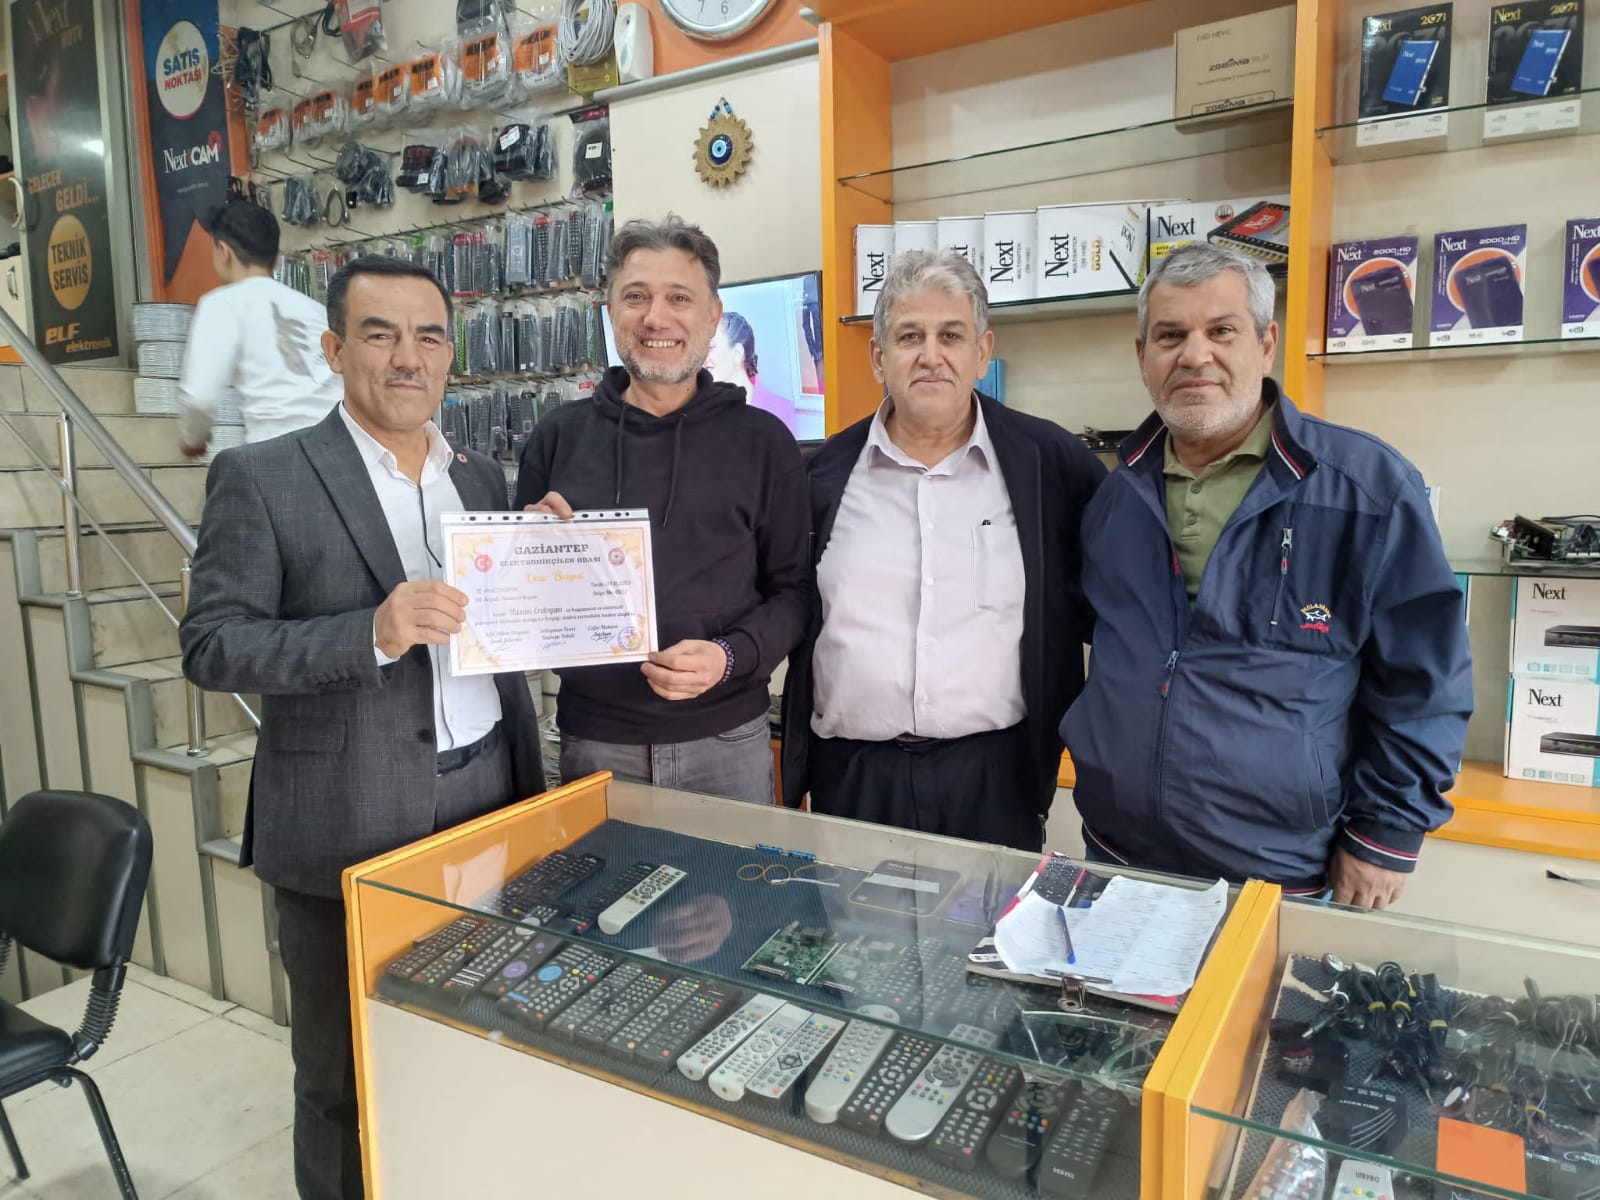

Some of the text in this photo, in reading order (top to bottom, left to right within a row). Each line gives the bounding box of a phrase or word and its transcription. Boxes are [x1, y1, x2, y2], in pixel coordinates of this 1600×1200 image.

[720, 0, 729, 15] 6
[1494, 8, 1521, 25] Next
[163, 142, 220, 174] Next CAM
[1156, 215, 1196, 239] Next
[50, 231, 87, 265] TEKNİK
[1440, 237, 1467, 253] Next
[990, 240, 1014, 283] Next
[1044, 233, 1070, 279] Next
[1337, 247, 1362, 263] Next
[52, 261, 89, 292] SERVİS
[862, 251, 885, 293] Next
[514, 543, 589, 556] GAZİANTEP
[576, 555, 601, 564] ODASI
[1531, 582, 1567, 600] Next
[1527, 688, 1563, 707] Next
